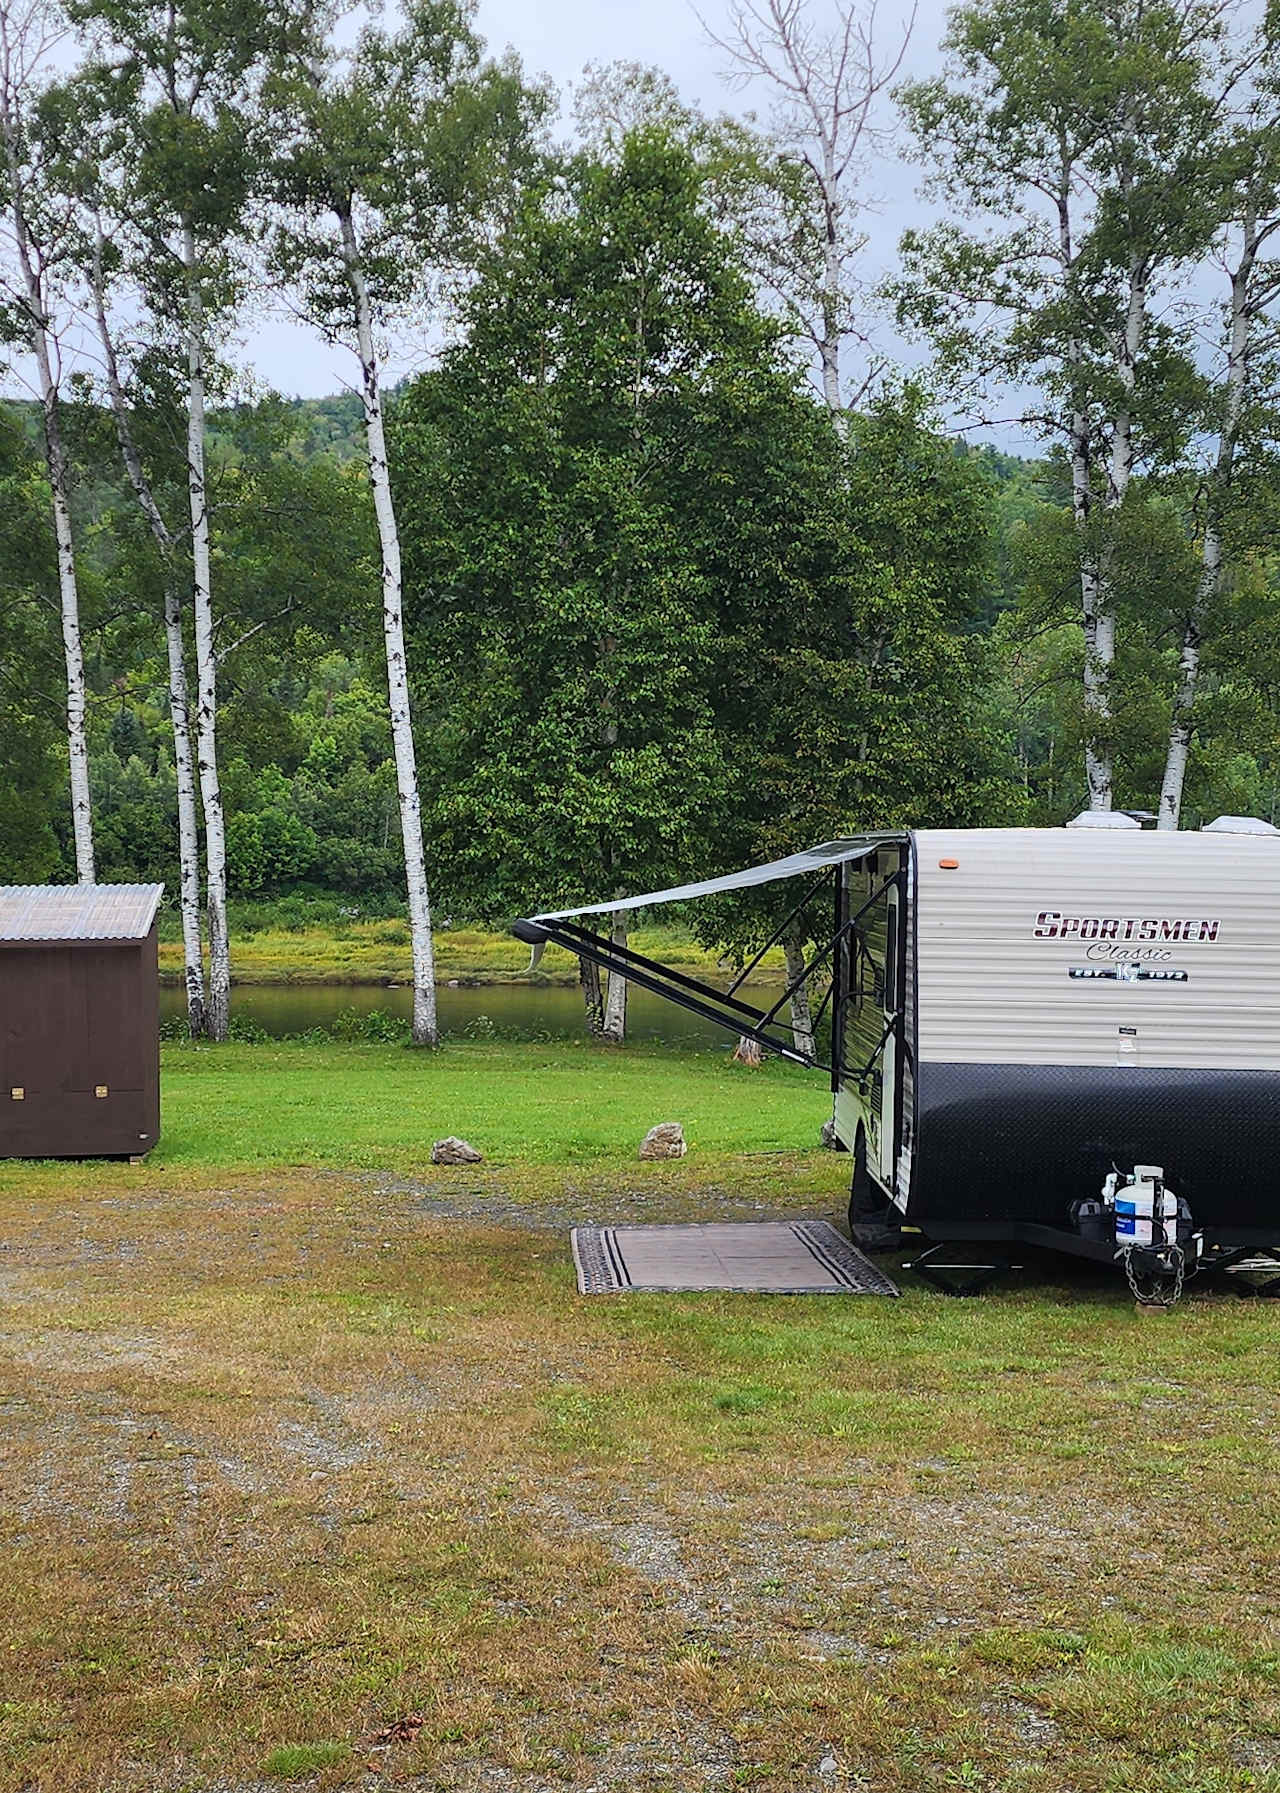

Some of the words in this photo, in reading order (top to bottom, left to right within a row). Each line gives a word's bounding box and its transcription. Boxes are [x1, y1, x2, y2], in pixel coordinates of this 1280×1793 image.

[1033, 910, 1221, 942] SPORTSMEN
[1086, 941, 1173, 962] Classic
[1074, 968, 1107, 978] EST.
[1148, 970, 1185, 980] 1972
